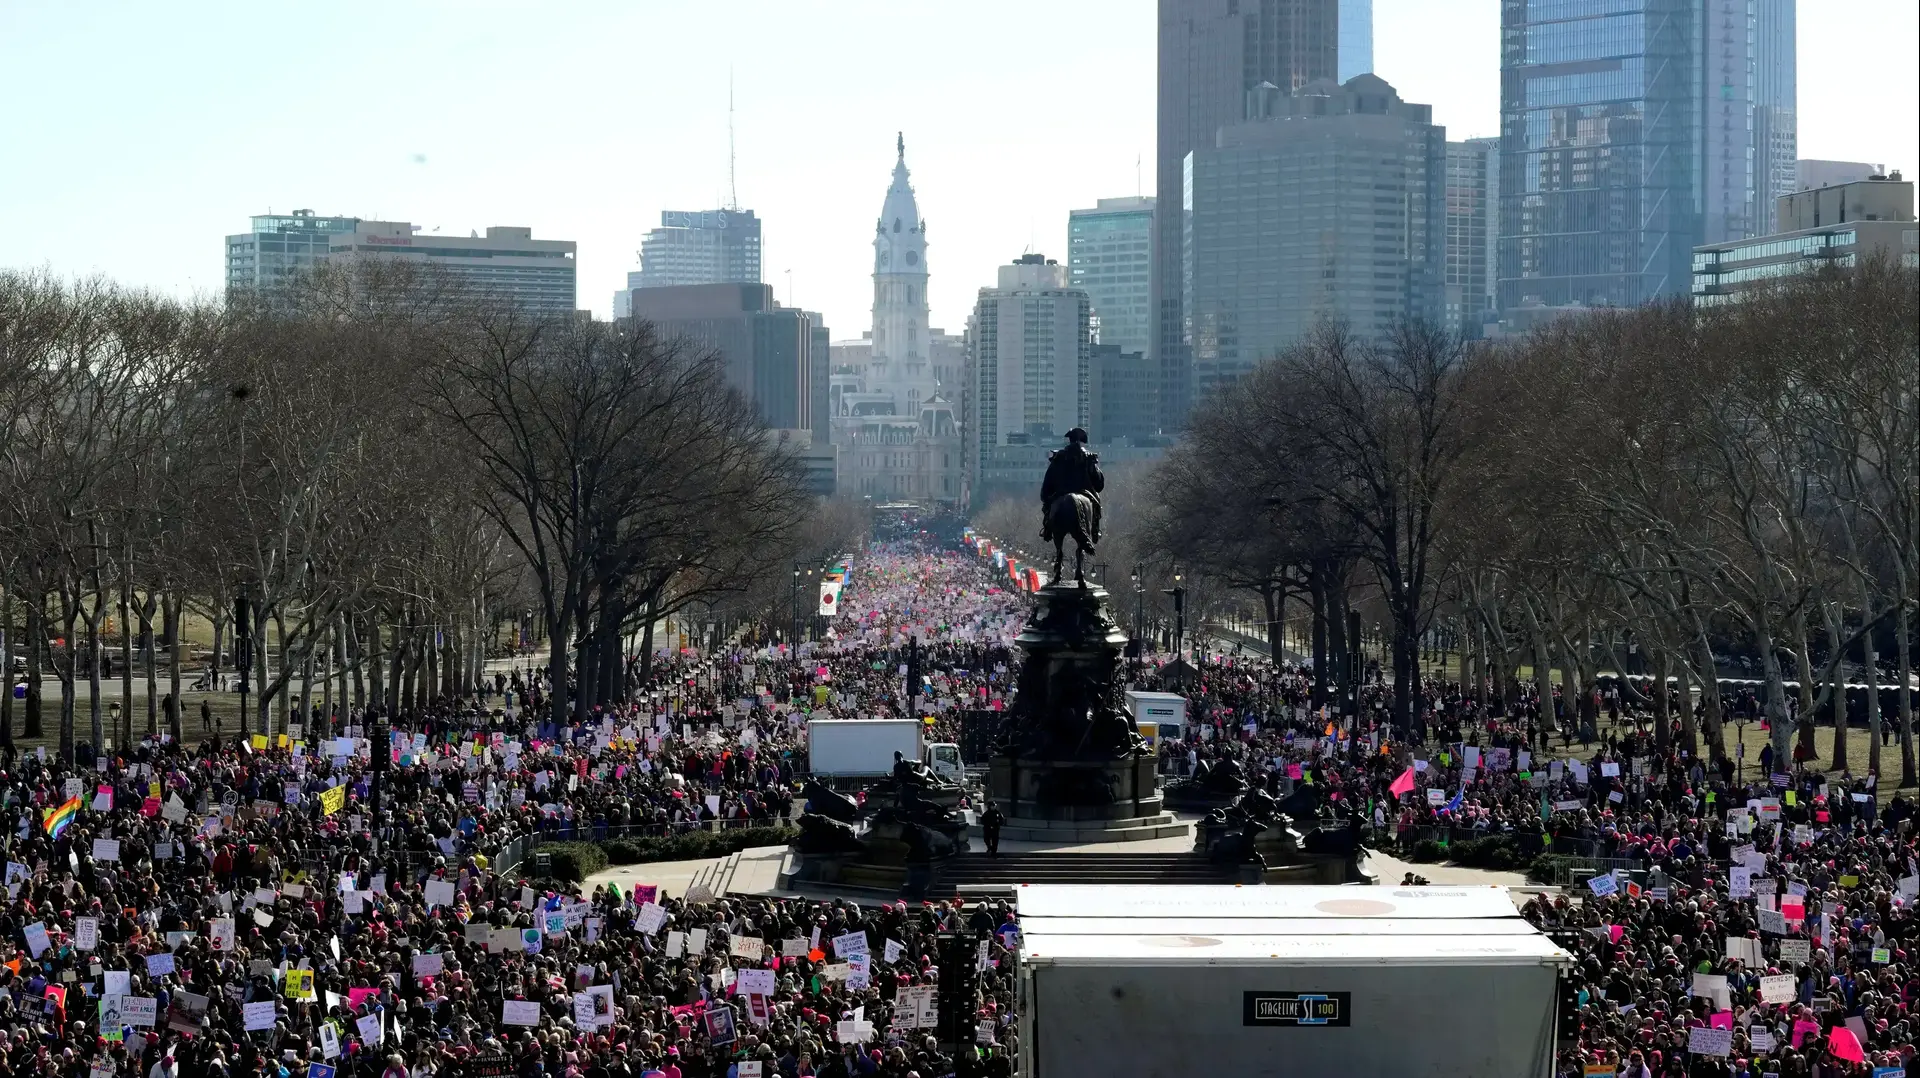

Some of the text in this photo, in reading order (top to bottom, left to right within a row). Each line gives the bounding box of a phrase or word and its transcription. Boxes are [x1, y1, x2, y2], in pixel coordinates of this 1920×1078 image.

[665, 211, 728, 229] PSFS
[366, 234, 412, 246] Sheraton
[546, 918, 564, 931] SHE
[567, 914, 583, 924] HER
[847, 979, 867, 989] The End
[1763, 975, 1793, 984] FEMINISM
[1764, 992, 1797, 1003] EVERYBODY
[30, 1009, 43, 1017] HAVE
[1260, 997, 1334, 1022] STAGELINE SL 100
[21, 1012, 36, 1022] SOME
[713, 1032, 735, 1044] NOPE
